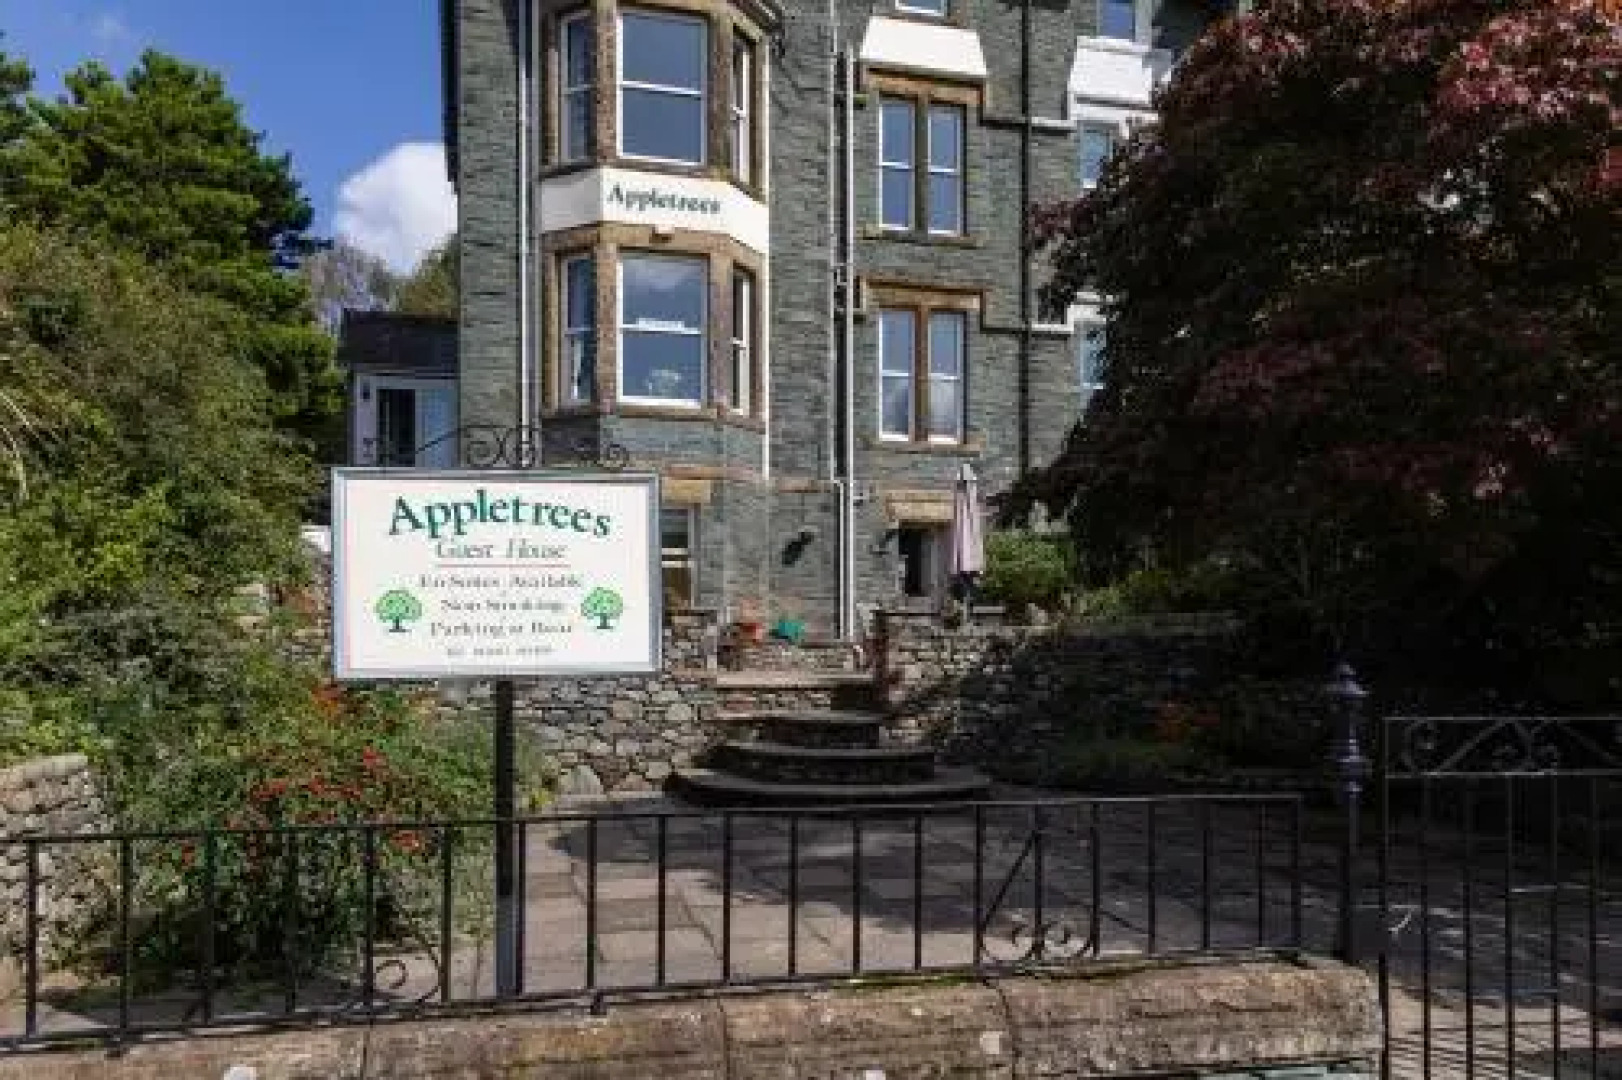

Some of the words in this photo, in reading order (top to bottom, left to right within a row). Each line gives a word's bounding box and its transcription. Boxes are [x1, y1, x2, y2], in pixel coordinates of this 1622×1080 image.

[607, 185, 721, 215] Appletrees
[388, 487, 611, 538] Appletrees
[435, 540, 494, 559] Guest
[504, 537, 567, 559] House
[510, 573, 582, 588] Available
[485, 597, 564, 614] Smoking
[430, 621, 505, 639] Parking
